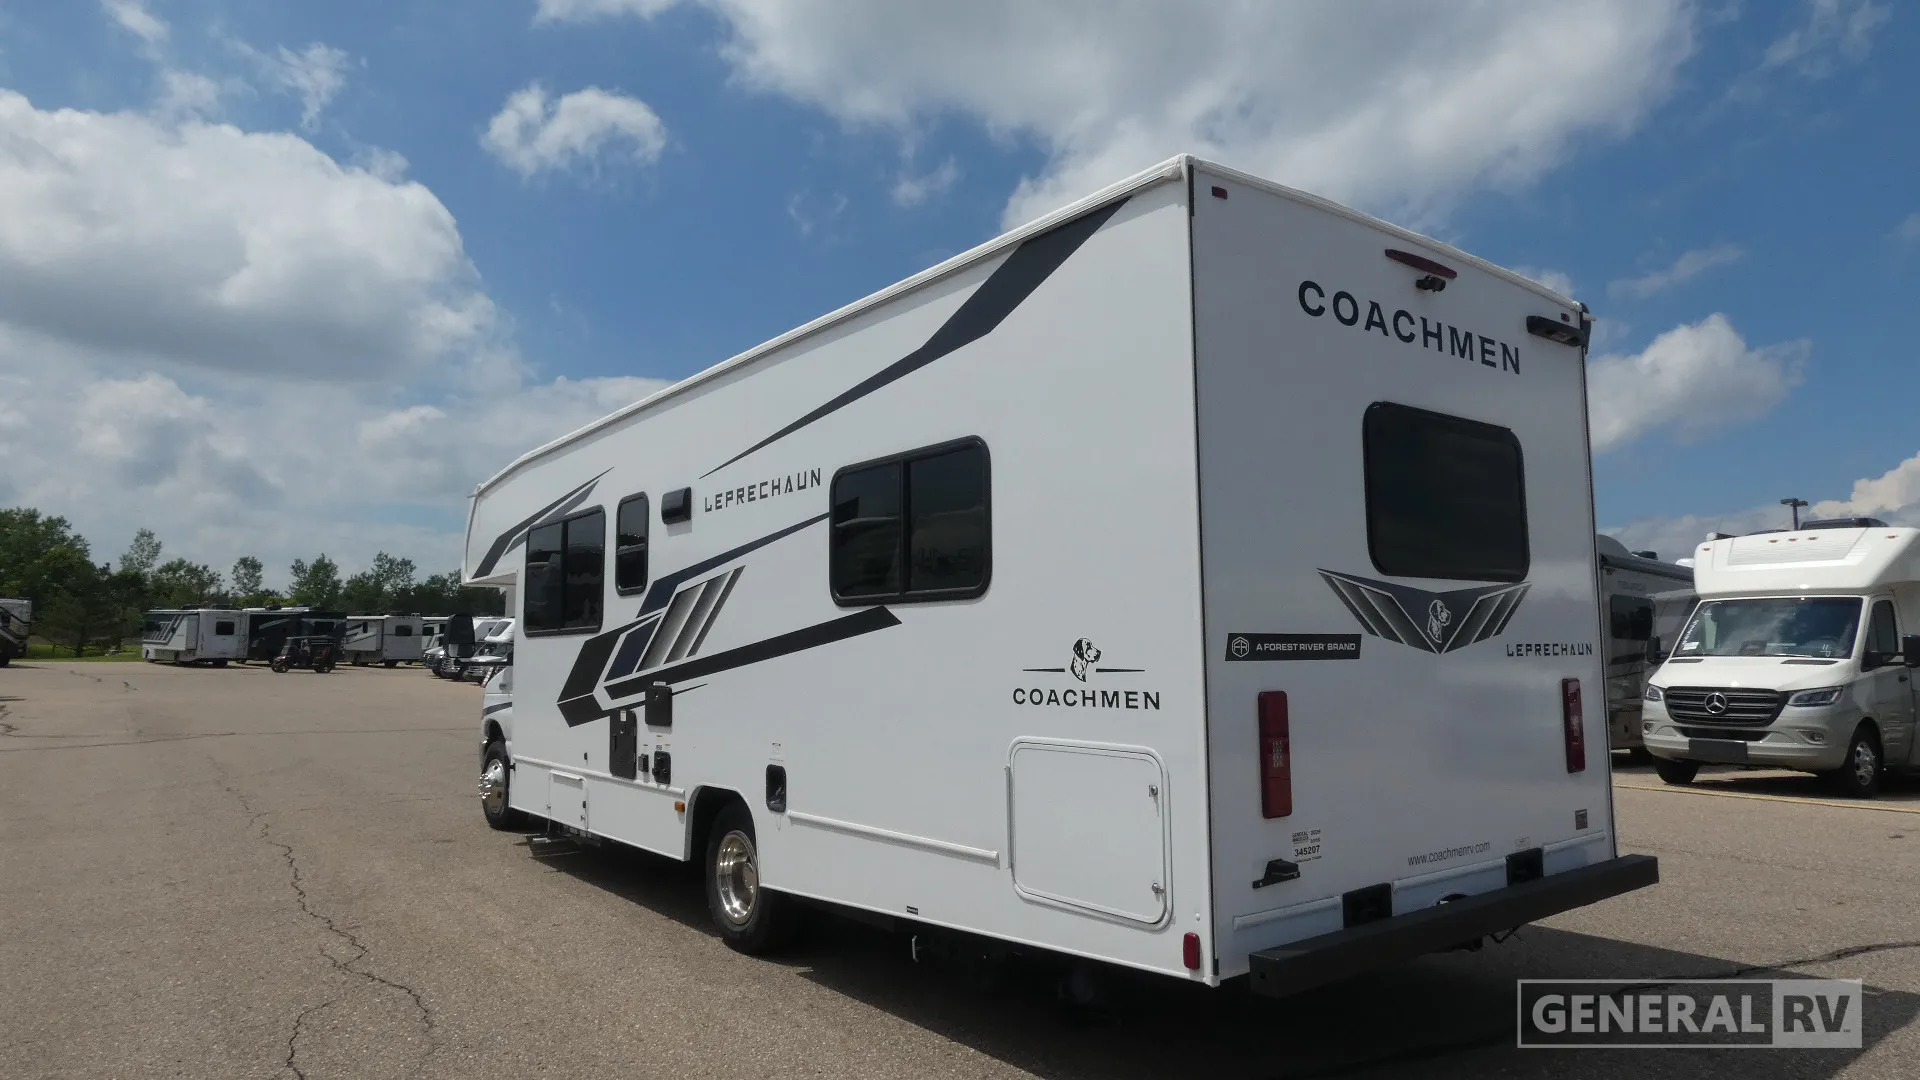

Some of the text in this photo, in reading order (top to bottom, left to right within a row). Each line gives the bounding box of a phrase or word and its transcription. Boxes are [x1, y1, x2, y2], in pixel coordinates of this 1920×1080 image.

[1298, 280, 1520, 375] COACHMEN
[704, 467, 821, 513] LEPRECHAUN
[1256, 643, 1356, 651] A FOREST RIVER BRAND
[1506, 643, 1593, 657] LEPRECHAUN
[1012, 688, 1161, 711] COACHMEN
[1294, 844, 1320, 857] 345207
[1407, 840, 1491, 866] www.coachmenrv.com
